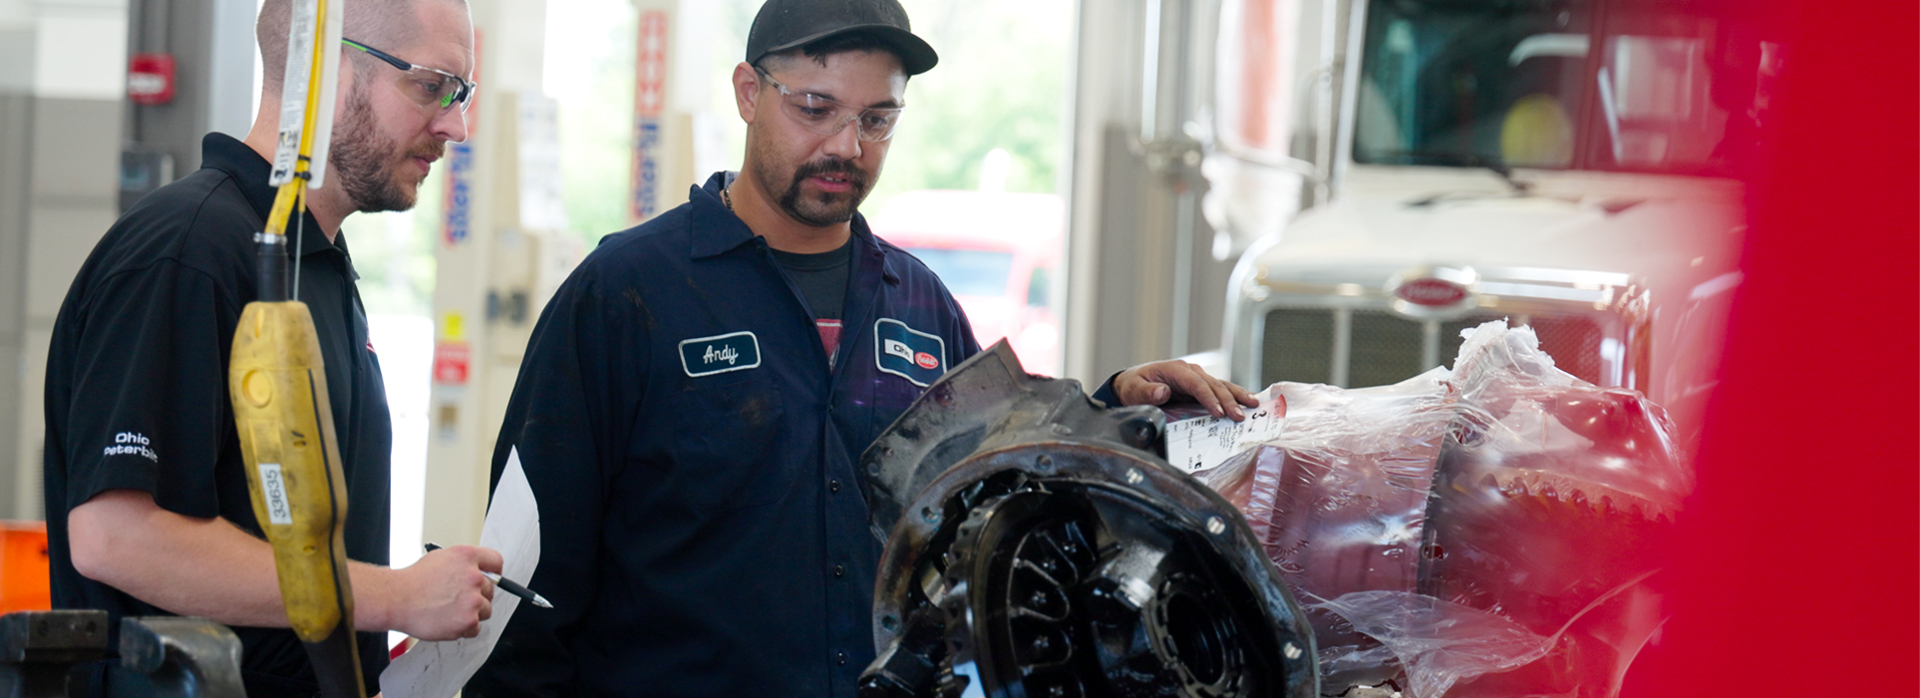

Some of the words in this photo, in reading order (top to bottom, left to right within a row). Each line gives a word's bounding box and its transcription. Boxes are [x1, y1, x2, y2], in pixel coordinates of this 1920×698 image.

[703, 344, 739, 365] Andy
[115, 431, 150, 445] Ohio
[264, 469, 287, 518] 33635
